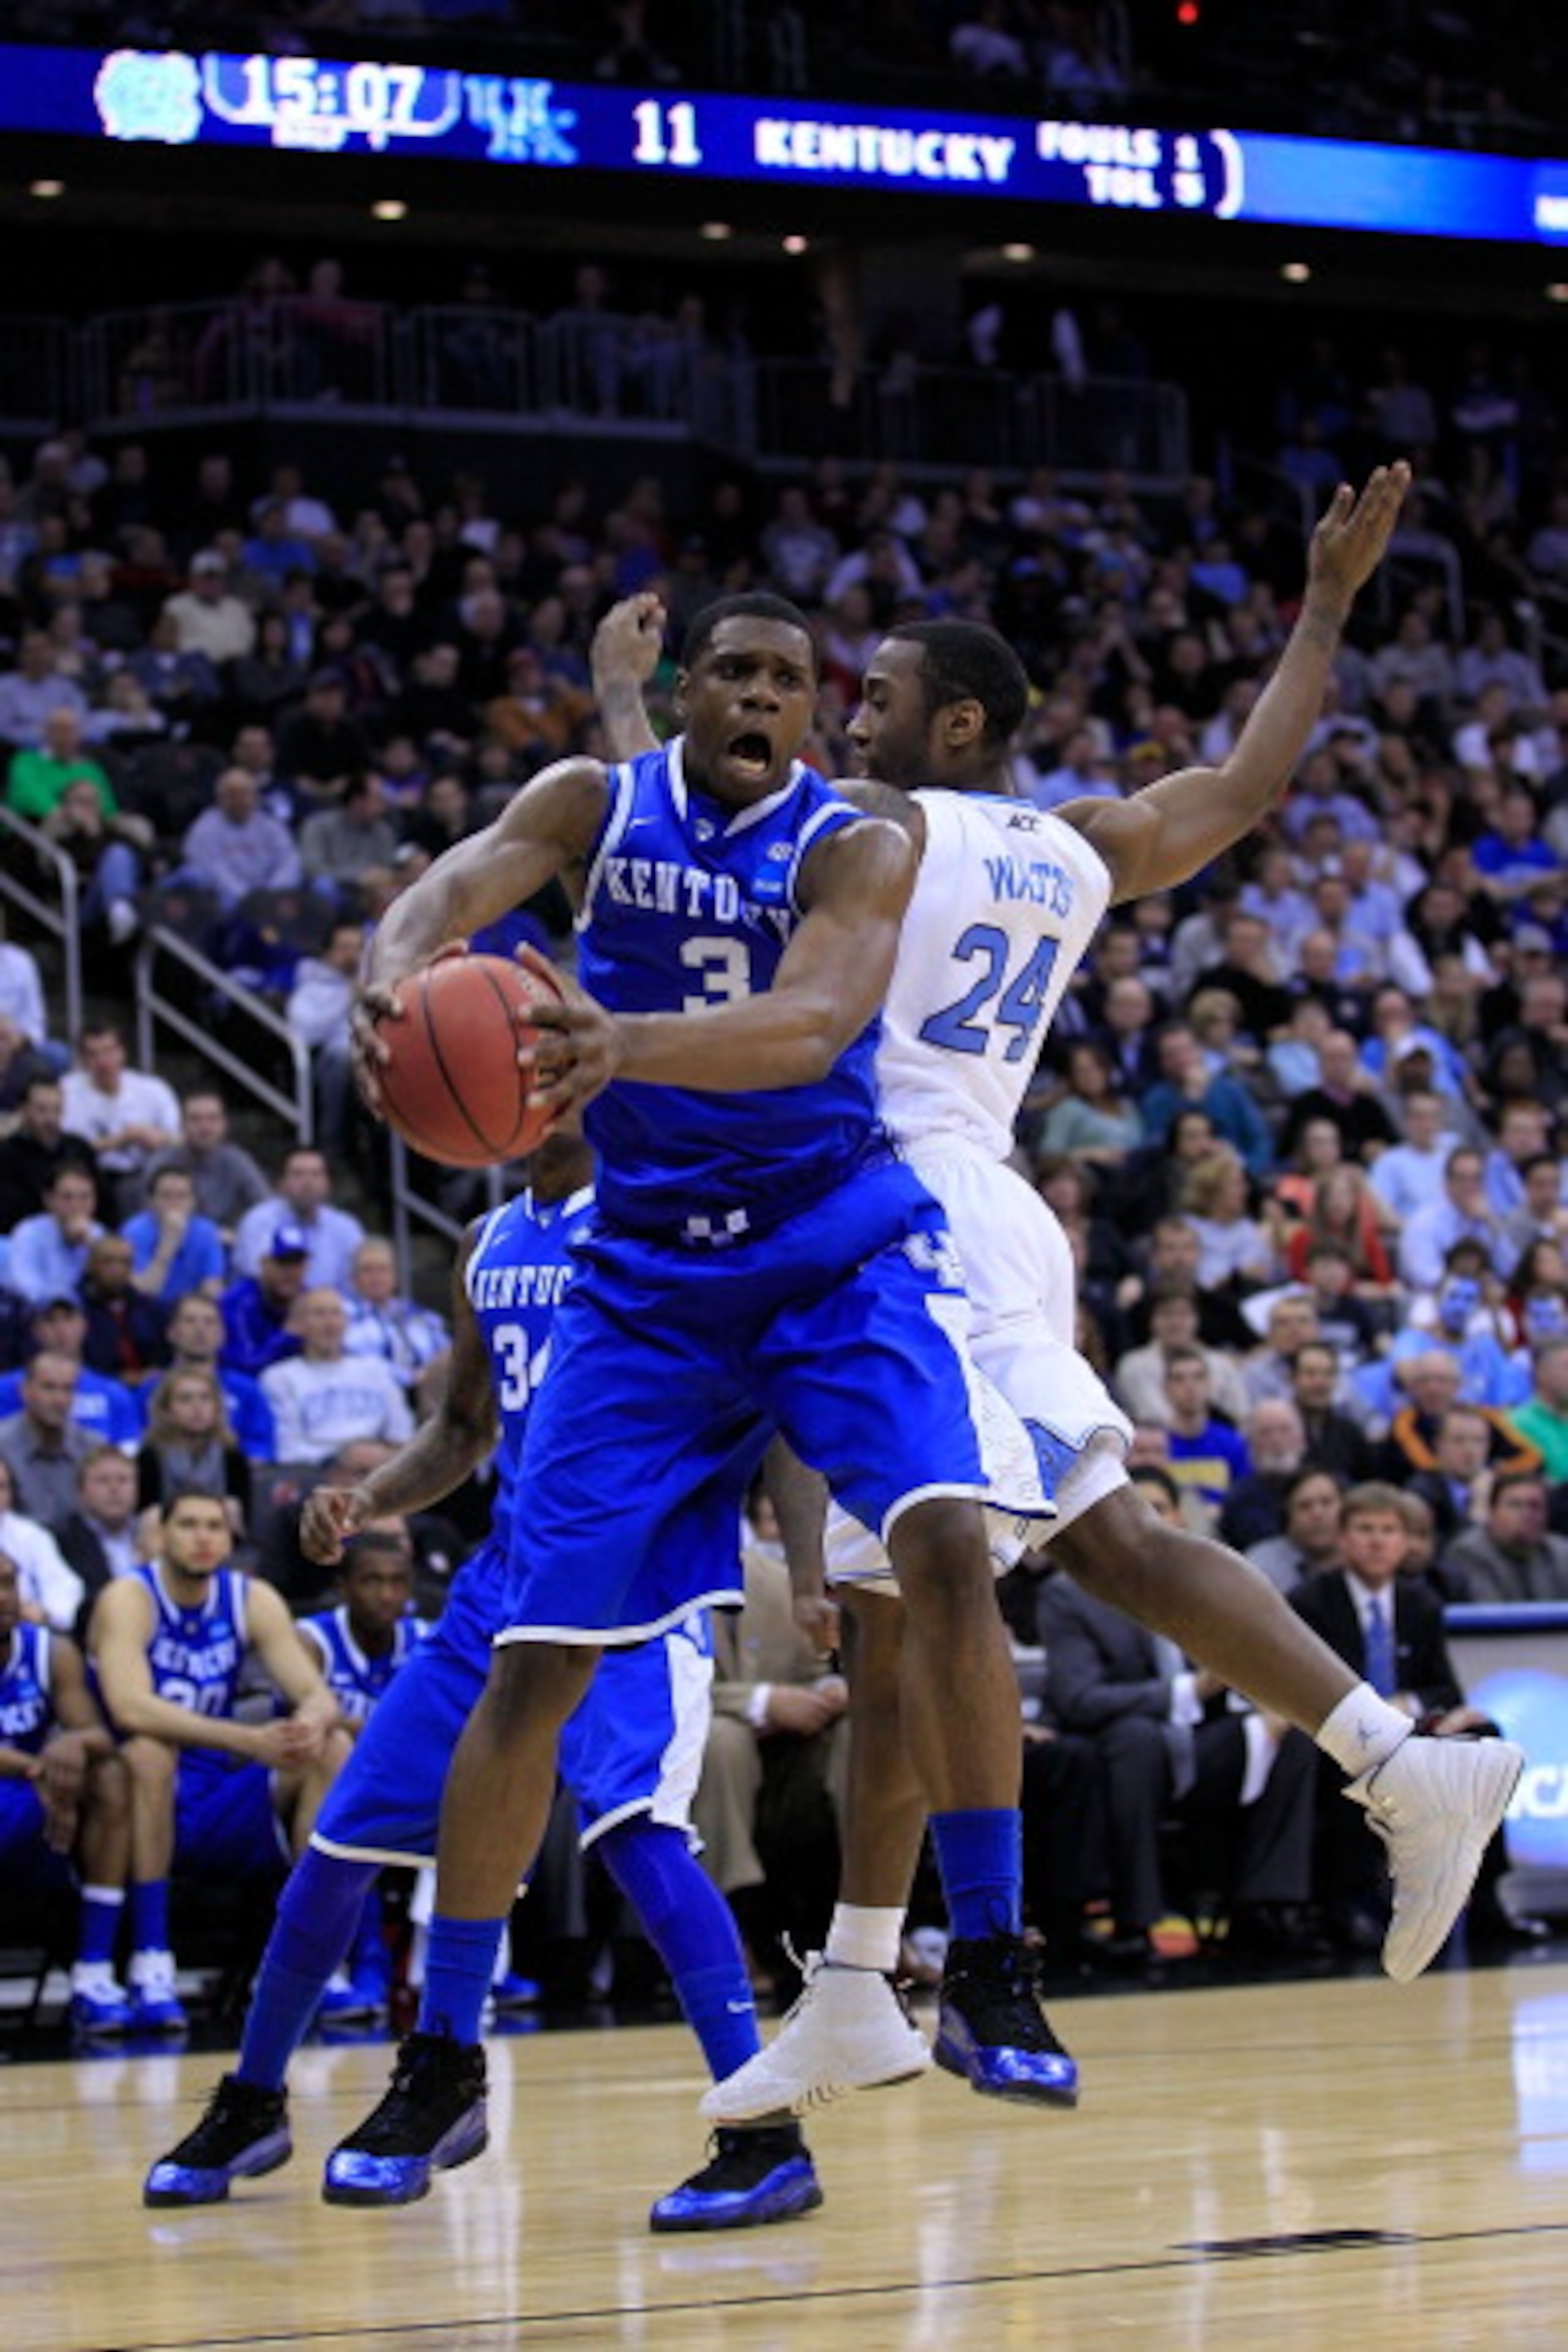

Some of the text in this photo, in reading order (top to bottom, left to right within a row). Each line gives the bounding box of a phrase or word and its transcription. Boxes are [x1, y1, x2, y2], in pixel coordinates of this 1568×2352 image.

[243, 55, 424, 124] 15:07
[633, 99, 1015, 183] 11 KENTUCKY
[1036, 121, 1163, 169] FOULS
[1083, 164, 1164, 208] TOL
[605, 856, 791, 944] KENTUY
[984, 854, 1074, 920] WATTS
[680, 935, 751, 1017] 3
[919, 922, 1060, 1063] 24
